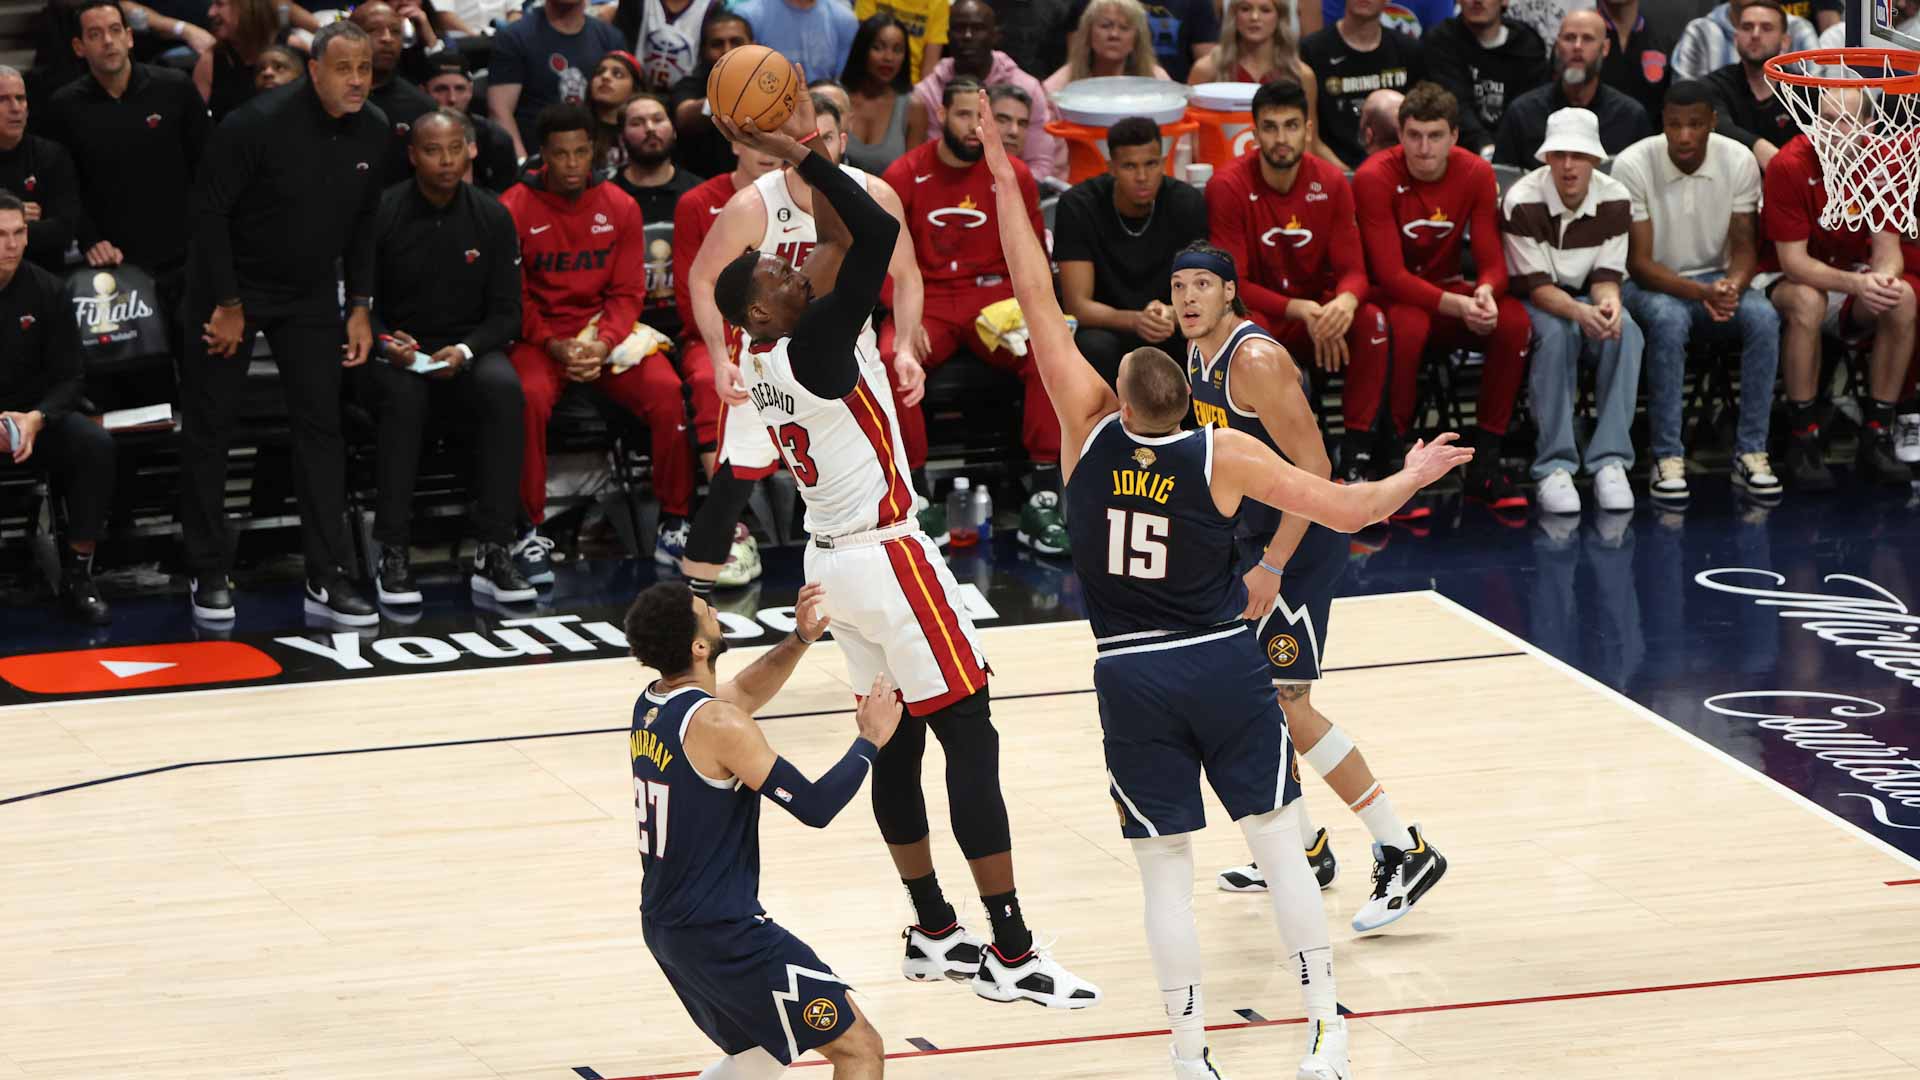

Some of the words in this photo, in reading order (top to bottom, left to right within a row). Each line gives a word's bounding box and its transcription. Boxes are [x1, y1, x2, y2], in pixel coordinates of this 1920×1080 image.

[591, 223, 614, 234] Chain
[779, 209, 789, 221] 6
[533, 242, 615, 272] HEAT
[775, 242, 817, 267] HE
[72, 290, 153, 328] Finals
[750, 382, 794, 415] DEBAYO
[1193, 399, 1230, 428] ENVER
[767, 421, 819, 487] 13
[1112, 470, 1175, 504] JOKIĆ
[1106, 507, 1170, 580] 15
[633, 776, 671, 860] 27
